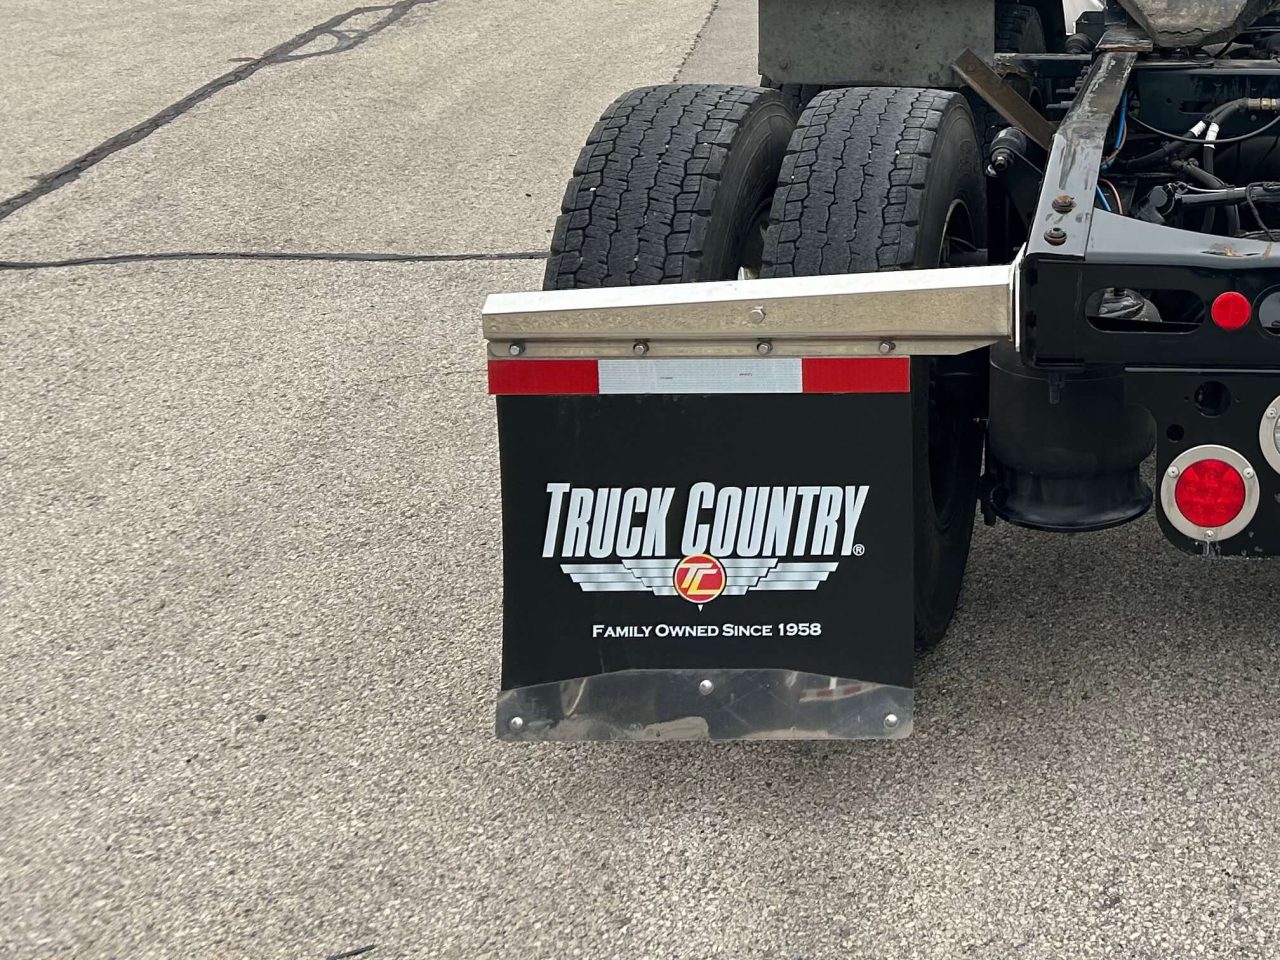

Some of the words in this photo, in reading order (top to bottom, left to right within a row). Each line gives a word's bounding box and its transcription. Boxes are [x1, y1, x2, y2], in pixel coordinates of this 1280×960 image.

[541, 482, 676, 558] TRUCK
[592, 623, 654, 639] FAMILY
[655, 623, 719, 638] OWNED
[722, 622, 773, 637] SINCE
[778, 622, 822, 637] 1958
